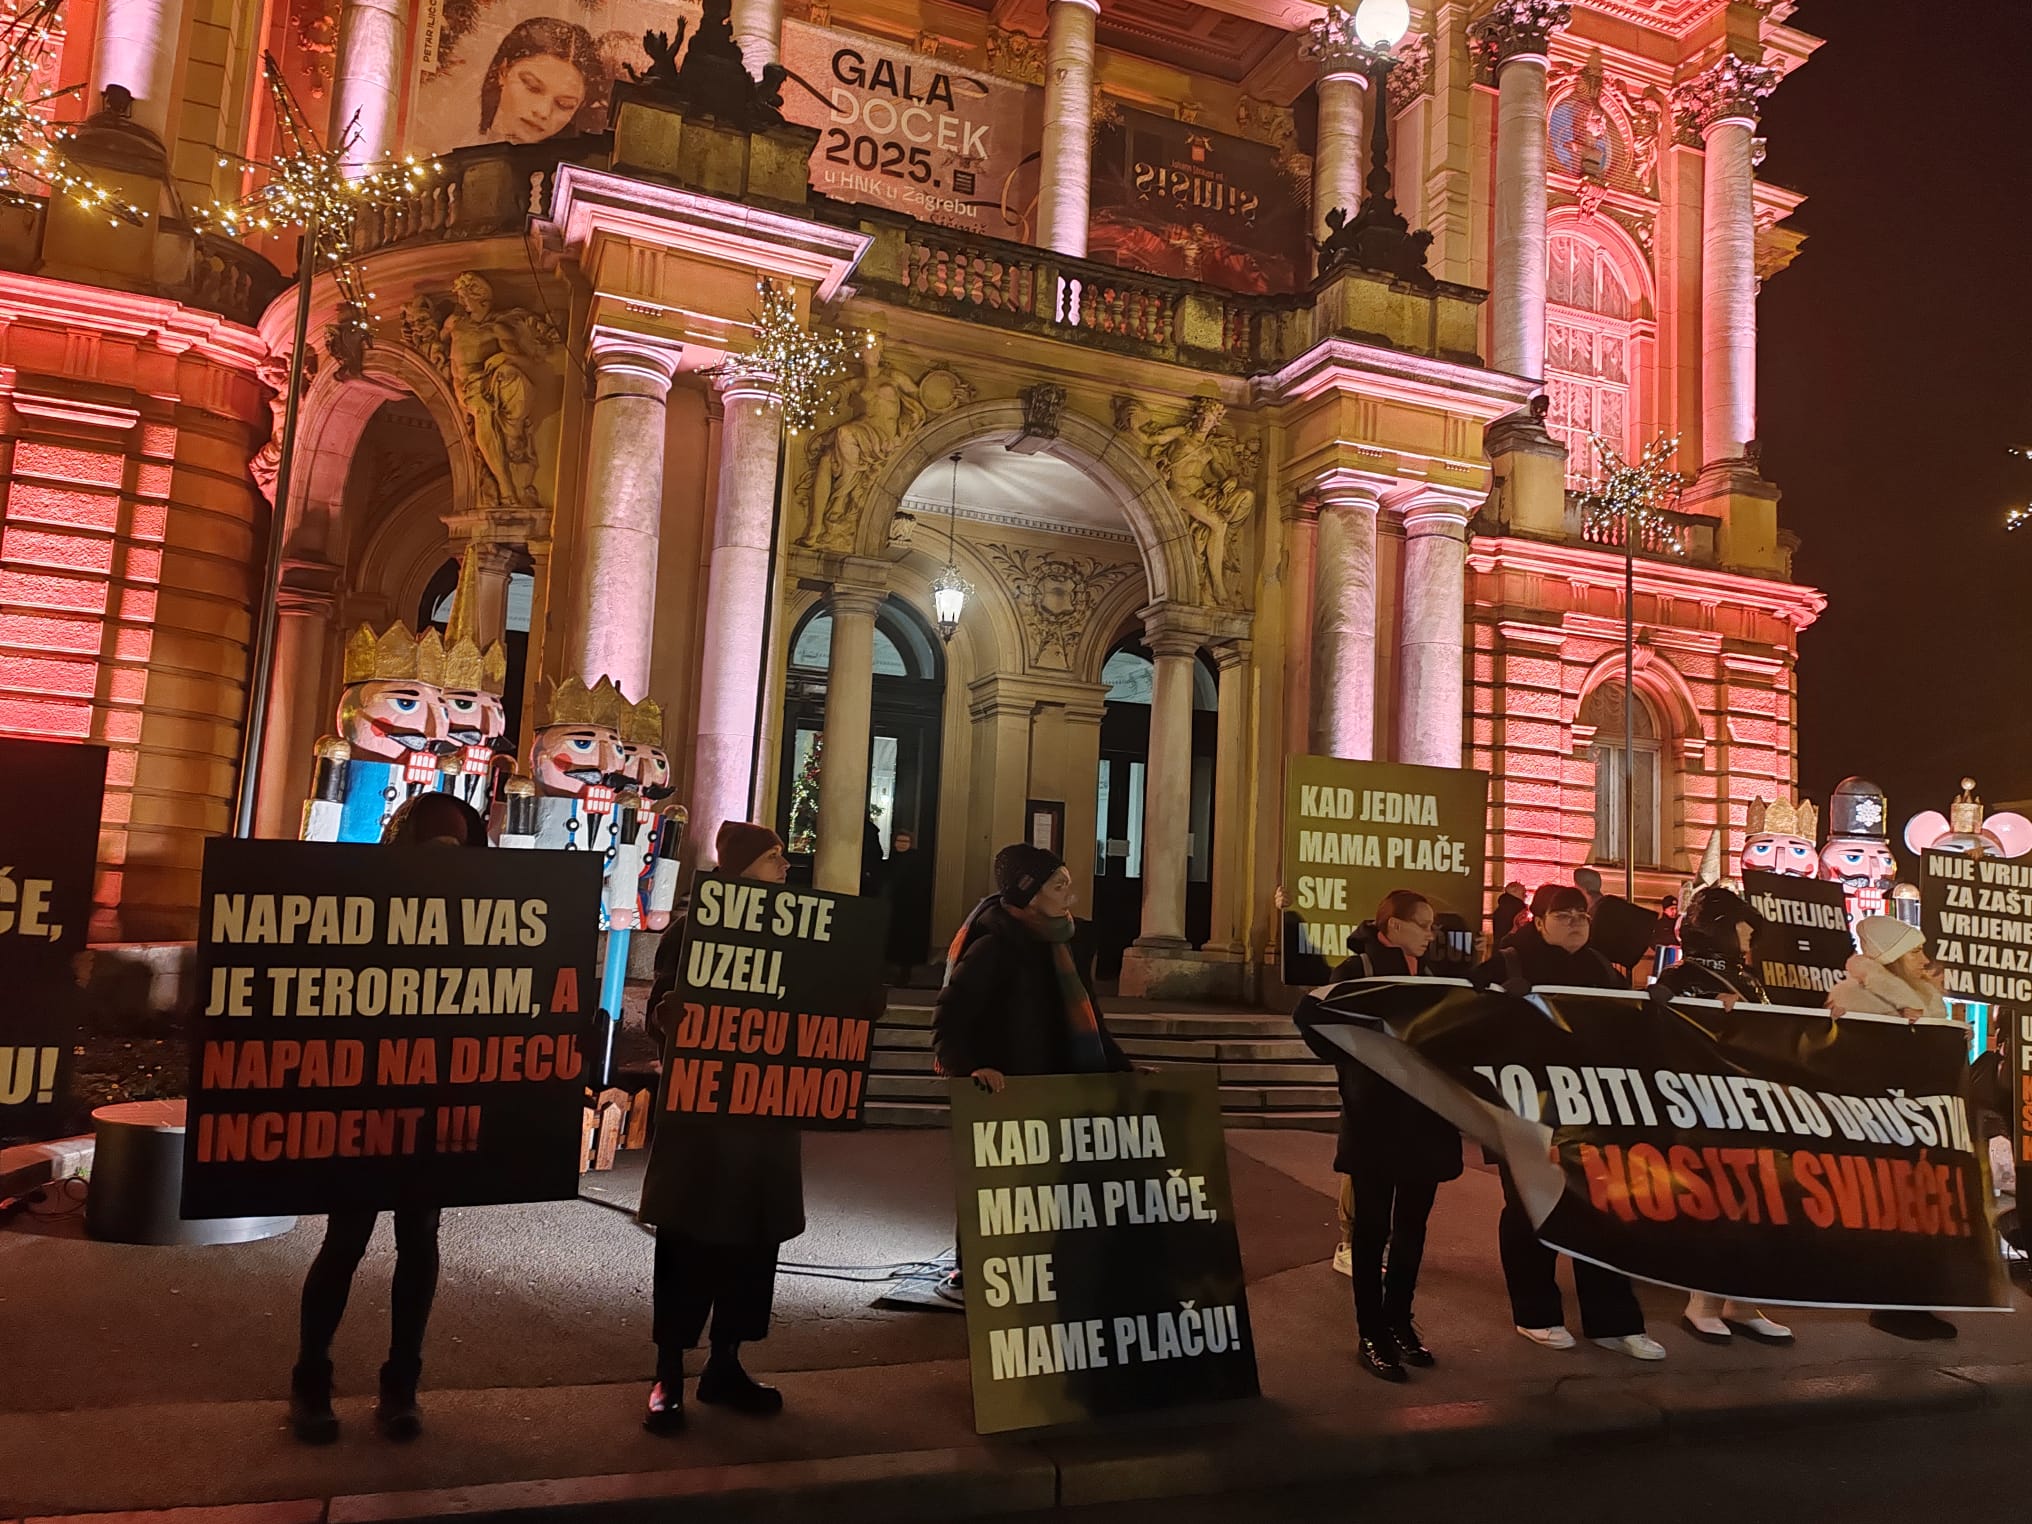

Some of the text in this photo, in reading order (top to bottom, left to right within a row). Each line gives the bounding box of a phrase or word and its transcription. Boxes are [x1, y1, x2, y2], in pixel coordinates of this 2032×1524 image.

[423, 29, 433, 63] PETAR
[832, 49, 954, 111] GALA
[830, 87, 990, 160] DOČEK
[826, 127, 941, 188] 2025.
[824, 170, 835, 184] u
[841, 171, 882, 197] HNK
[887, 186, 898, 200] u
[902, 185, 978, 218] Zagrebu
[1300, 785, 1439, 827] KAD JEDNA
[1299, 830, 1471, 876] MAMA PLAČE,
[1929, 855, 1975, 881] NIJE
[211, 893, 548, 947] NAPAD NA VAS
[697, 879, 835, 942] SVE STE
[1298, 875, 1347, 911] SVE
[1946, 885, 1975, 909] ZA
[1936, 939, 1965, 962] ZA
[1940, 911, 2032, 945] VRIJEME
[205, 967, 579, 1019] JE TERORIZAM, A
[687, 940, 787, 1000] UZELI,
[1943, 968, 1976, 993] NA
[676, 1003, 870, 1062] DJECU VAM
[202, 1034, 582, 1090] NAPAD NA DJECU
[666, 1057, 862, 1120] NE DAMO!
[1546, 1065, 1658, 1127] BITI
[1654, 1070, 1834, 1140] SVJETLO
[197, 1105, 482, 1162] INCIDENT !!!
[972, 1115, 1167, 1168] KAD JEDNA
[977, 1168, 1217, 1236] MAMA PLAČE,
[1581, 1142, 1789, 1226] NOSITI
[983, 1253, 1057, 1308] SVE
[989, 1300, 1241, 1381] MAME PLAČU!
